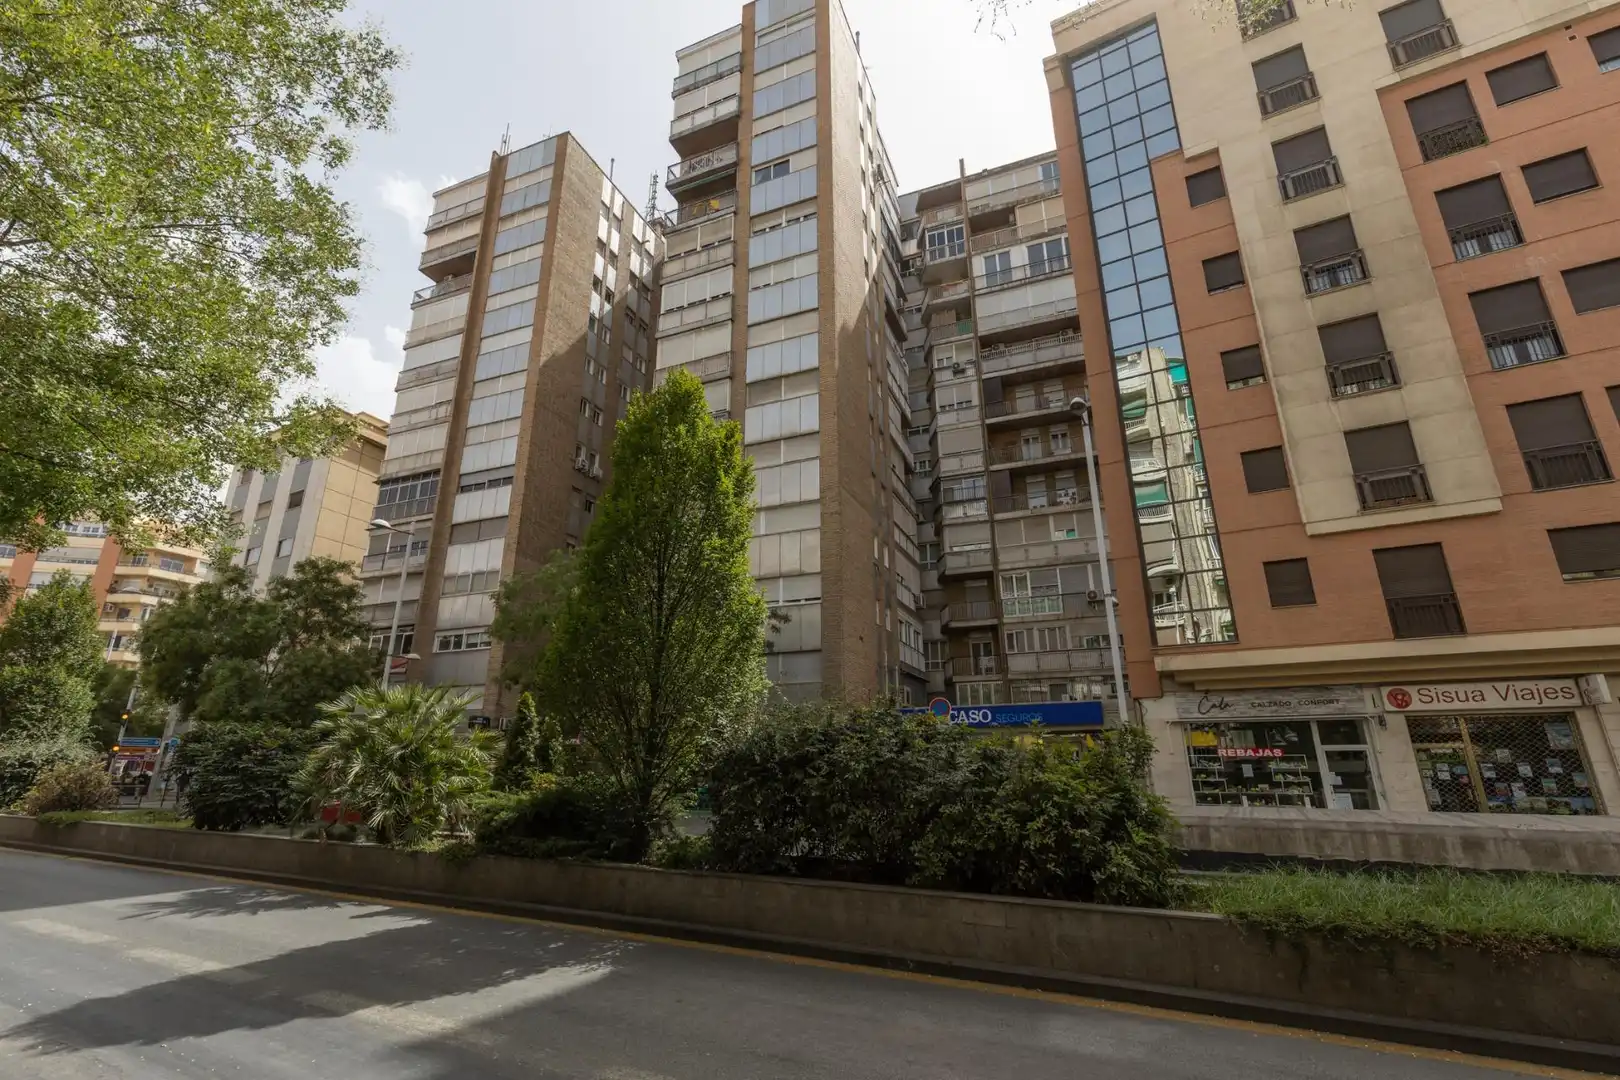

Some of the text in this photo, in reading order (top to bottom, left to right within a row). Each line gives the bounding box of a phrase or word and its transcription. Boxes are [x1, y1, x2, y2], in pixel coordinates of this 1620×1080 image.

[1417, 687, 1486, 704] Sisua
[1491, 684, 1576, 705] Viajes
[1250, 698, 1341, 708] CALZADO CONFORT
[930, 708, 1044, 725] CASO SEGUROS
[1217, 748, 1283, 757] REBAJAS
